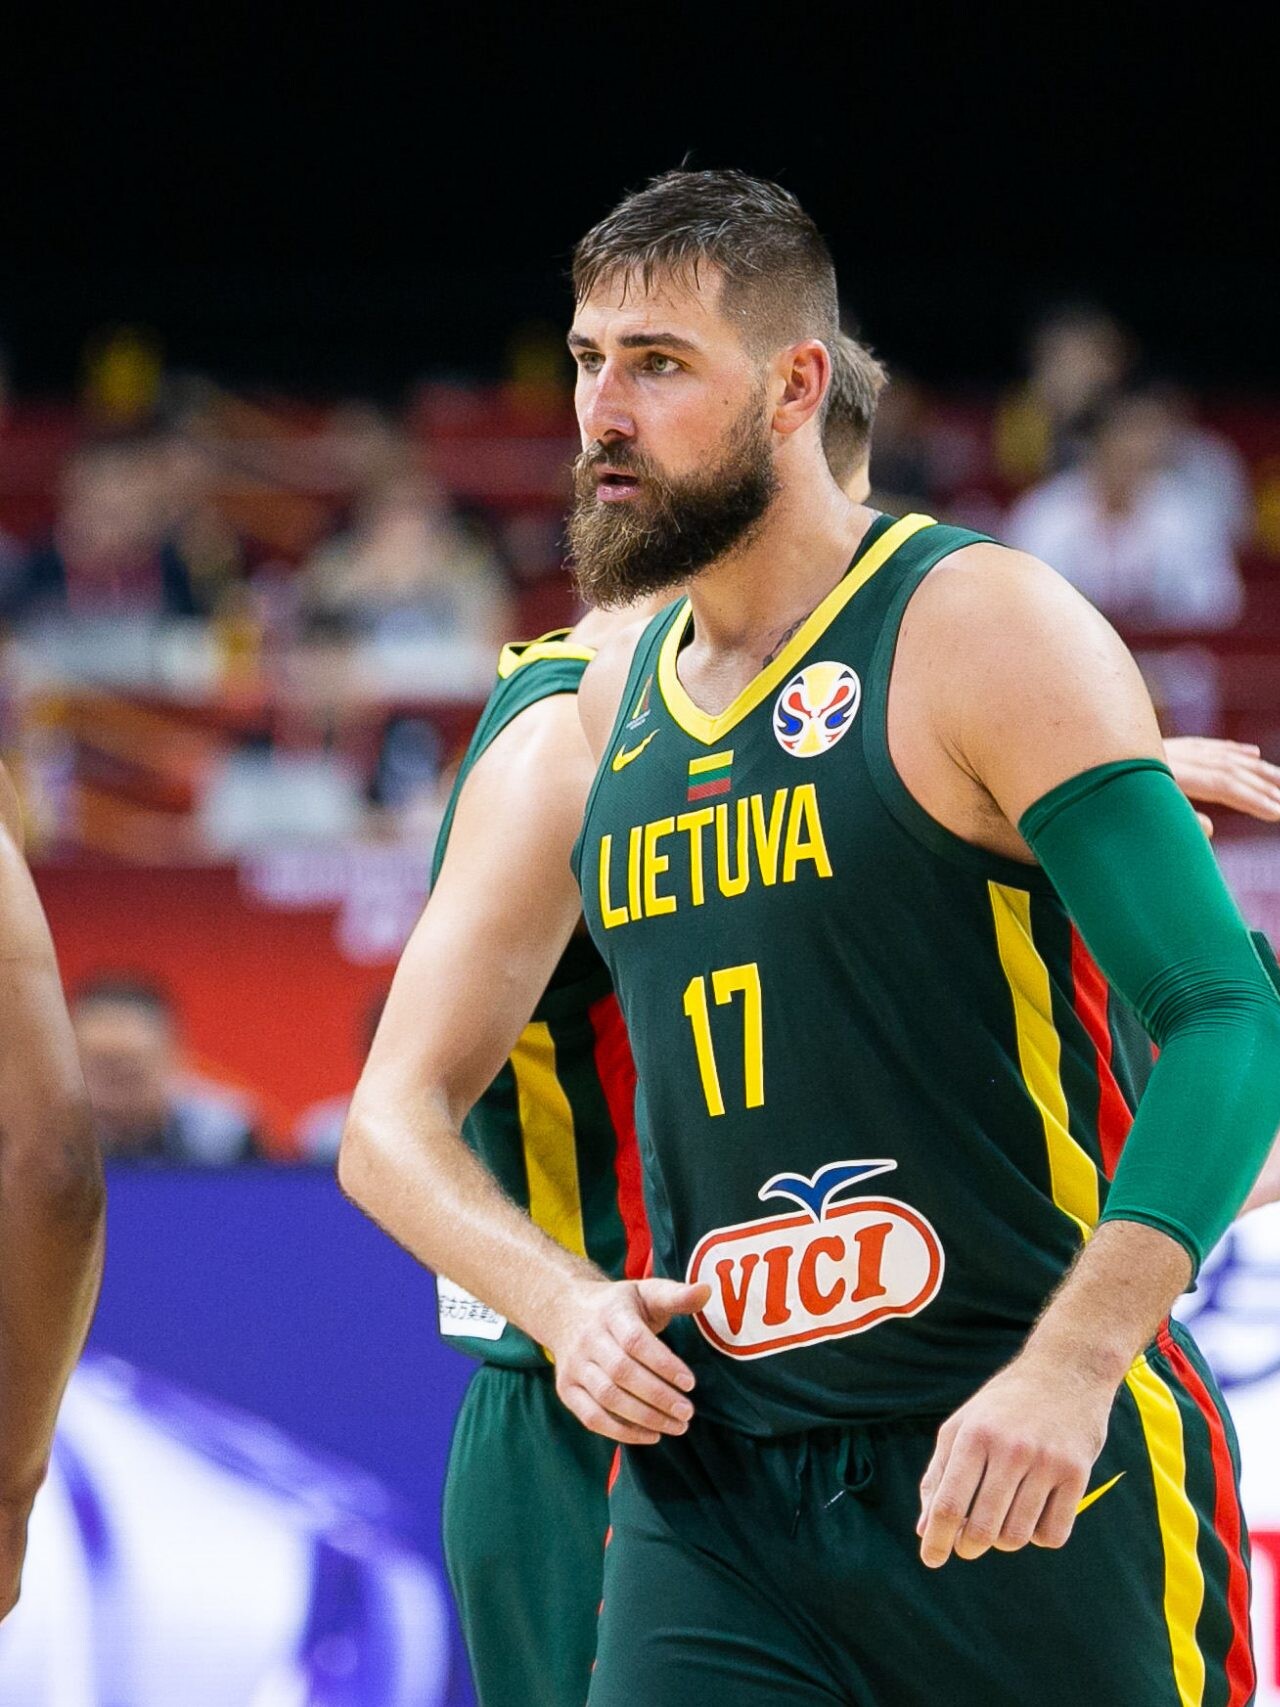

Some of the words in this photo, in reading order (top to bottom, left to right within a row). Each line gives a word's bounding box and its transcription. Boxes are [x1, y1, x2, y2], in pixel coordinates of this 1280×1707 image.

[600, 783, 833, 929] LIETUVA
[683, 962, 764, 1117] 17
[715, 1221, 894, 1336] VICI
